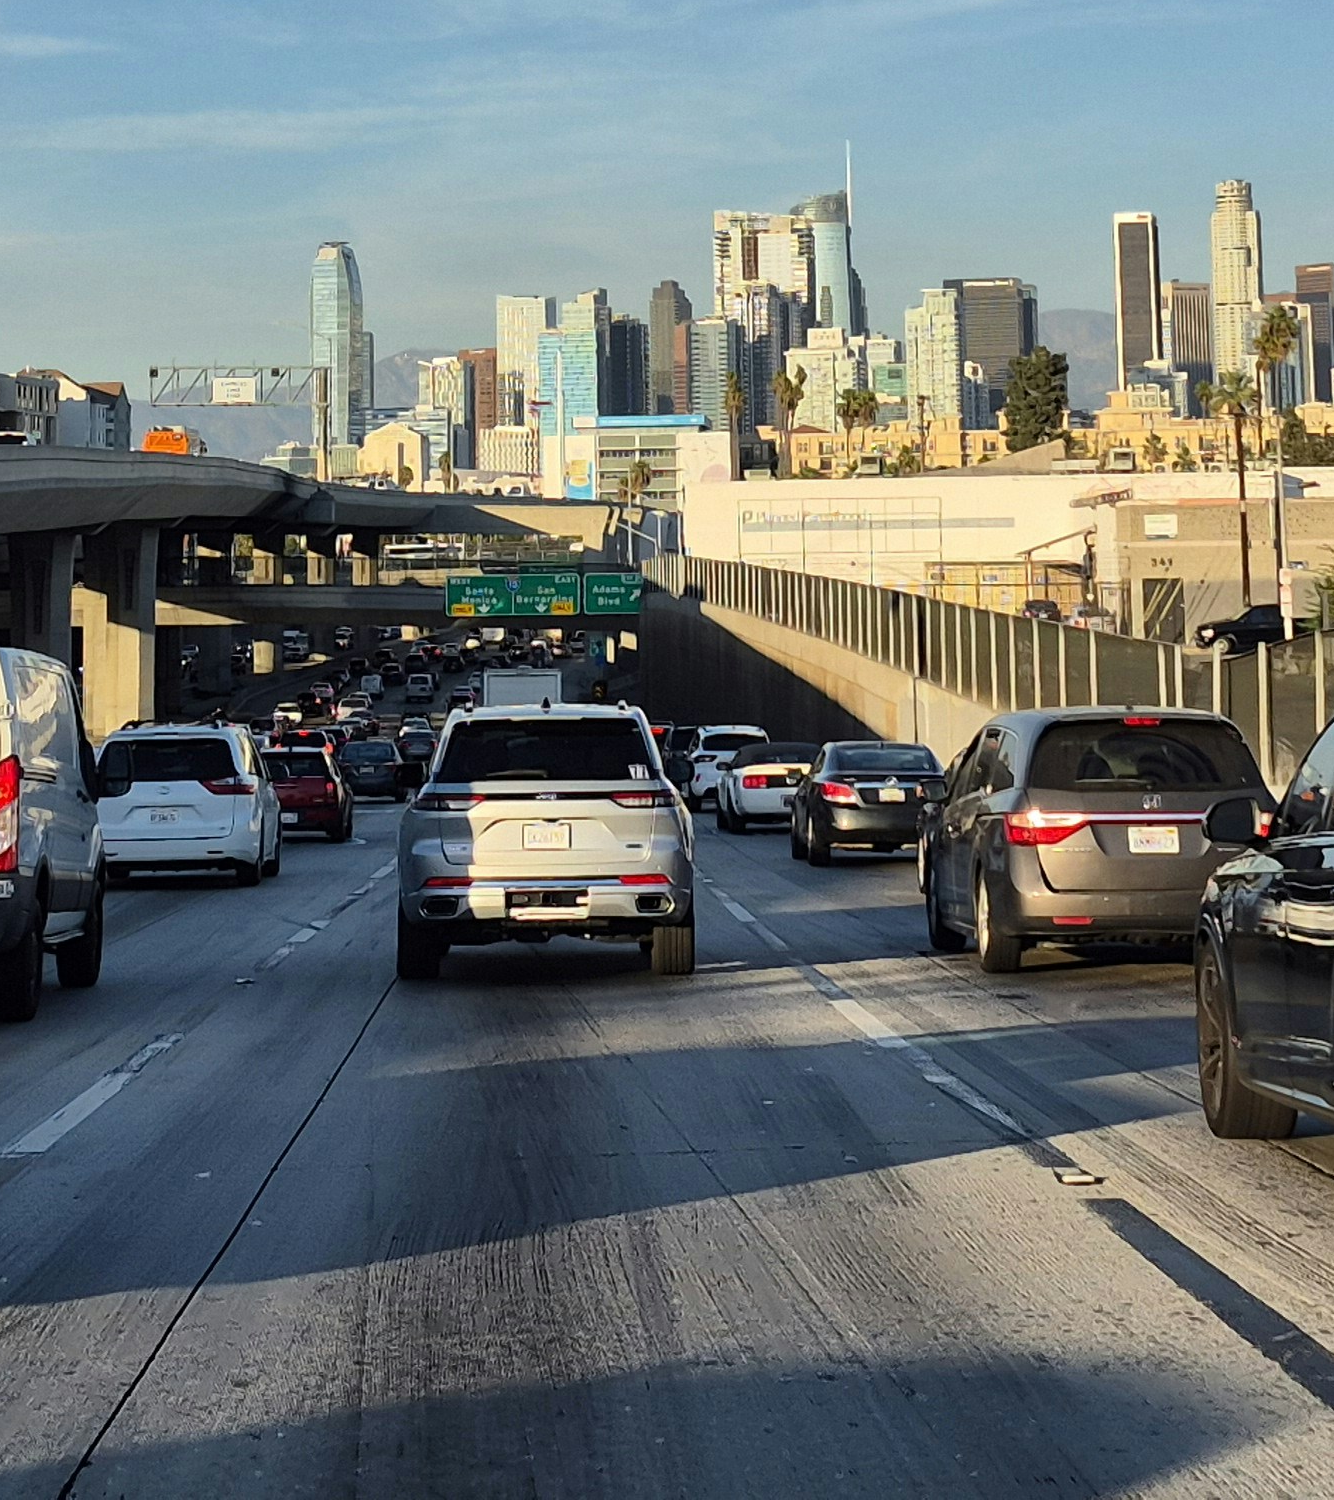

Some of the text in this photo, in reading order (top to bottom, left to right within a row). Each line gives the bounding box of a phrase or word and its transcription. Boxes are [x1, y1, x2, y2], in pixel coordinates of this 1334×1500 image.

[465, 586, 495, 596] Santa
[537, 586, 556, 595] San
[592, 584, 626, 594] Adams
[461, 596, 498, 605] Monica
[597, 596, 620, 606] Blvd
